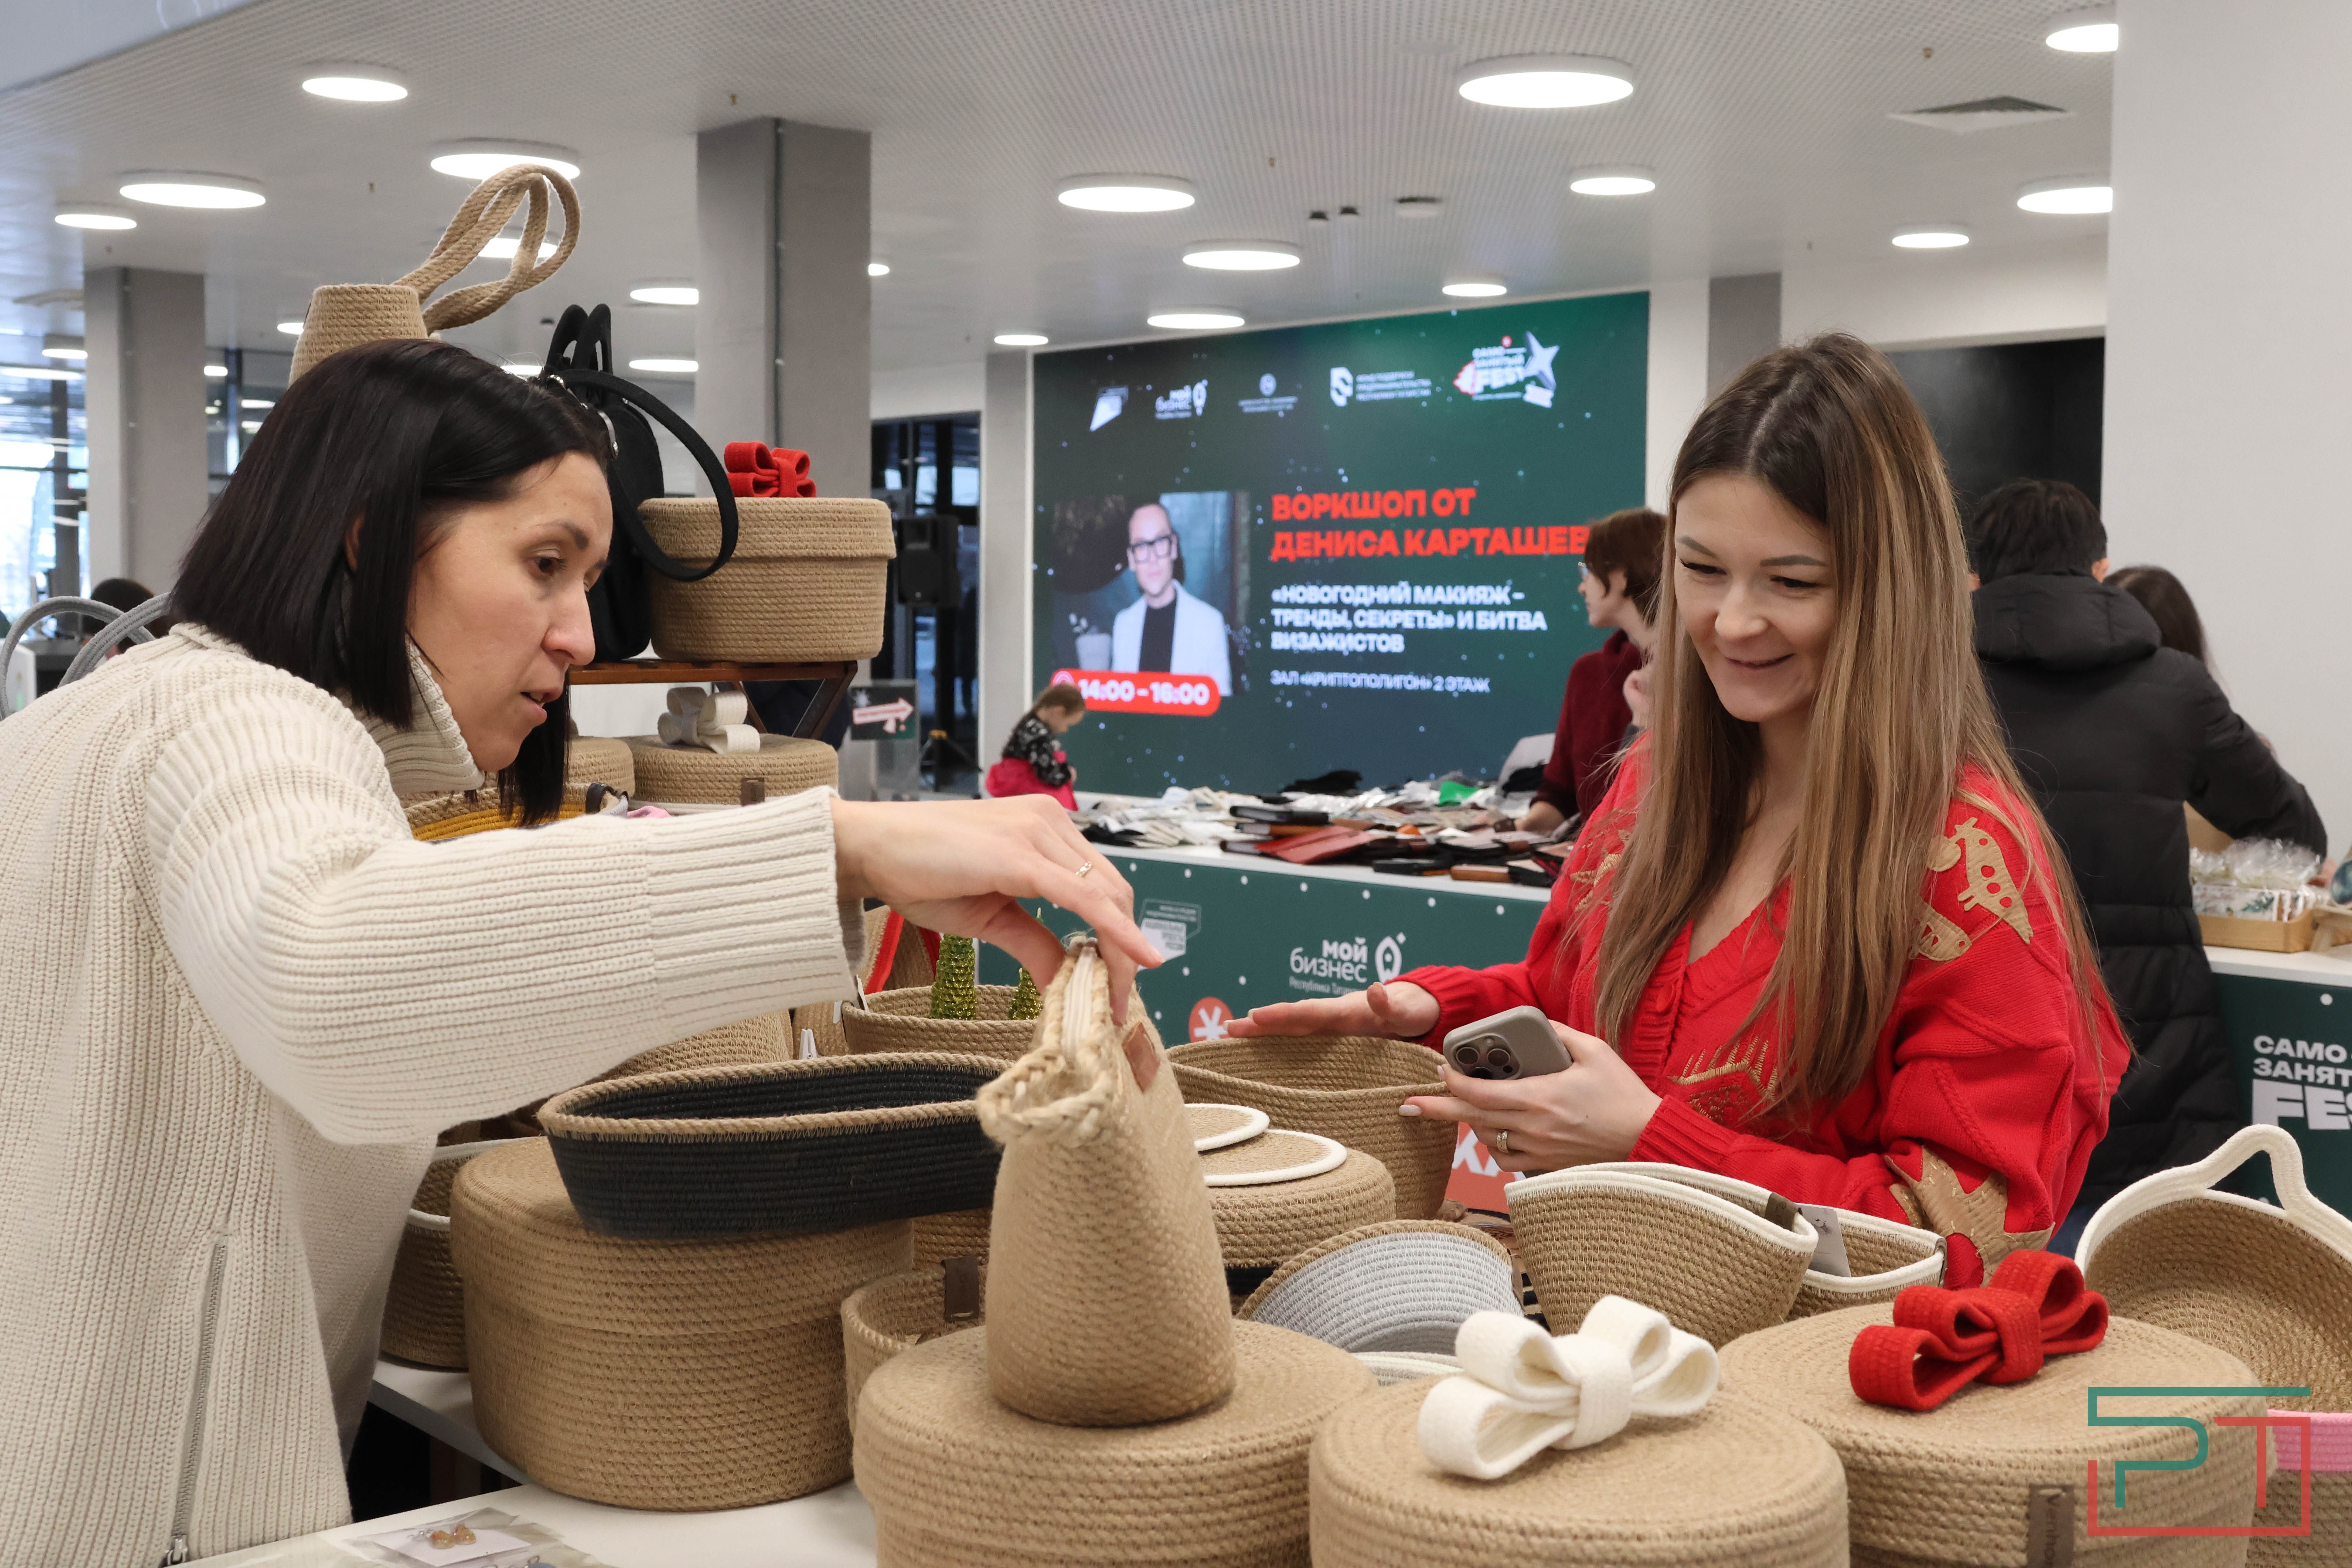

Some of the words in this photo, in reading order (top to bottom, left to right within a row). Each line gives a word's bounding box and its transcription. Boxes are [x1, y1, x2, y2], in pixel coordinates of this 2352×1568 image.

[1273, 490, 1426, 519] ВОРКШОП
[1431, 488, 1476, 517] ОТ
[1271, 529, 1400, 562] ДЕНИСА
[1271, 581, 1411, 607] «НОВОГОДНИЙ
[1414, 585, 1512, 605] МАКИЯЖ
[1271, 609, 1353, 630] ТРЕНДЫ,
[1353, 609, 1455, 628] СЕКРЕТЫ»
[1456, 610, 1474, 629] И
[1476, 611, 1547, 630] БИТВА
[1271, 632, 1405, 652] ВИЗАЖИСТОВ
[1078, 679, 1135, 701] 14:00
[1149, 682, 1210, 705] 16:00
[1270, 670, 1300, 685] ЗАЛ
[1433, 676, 1443, 691] 2
[1444, 676, 1491, 693] ЭТАЖ
[1322, 937, 1368, 964] мой
[1290, 947, 1367, 983] бизнес
[2253, 1035, 2347, 1063] САМО
[2251, 1078, 2352, 1130] FE
